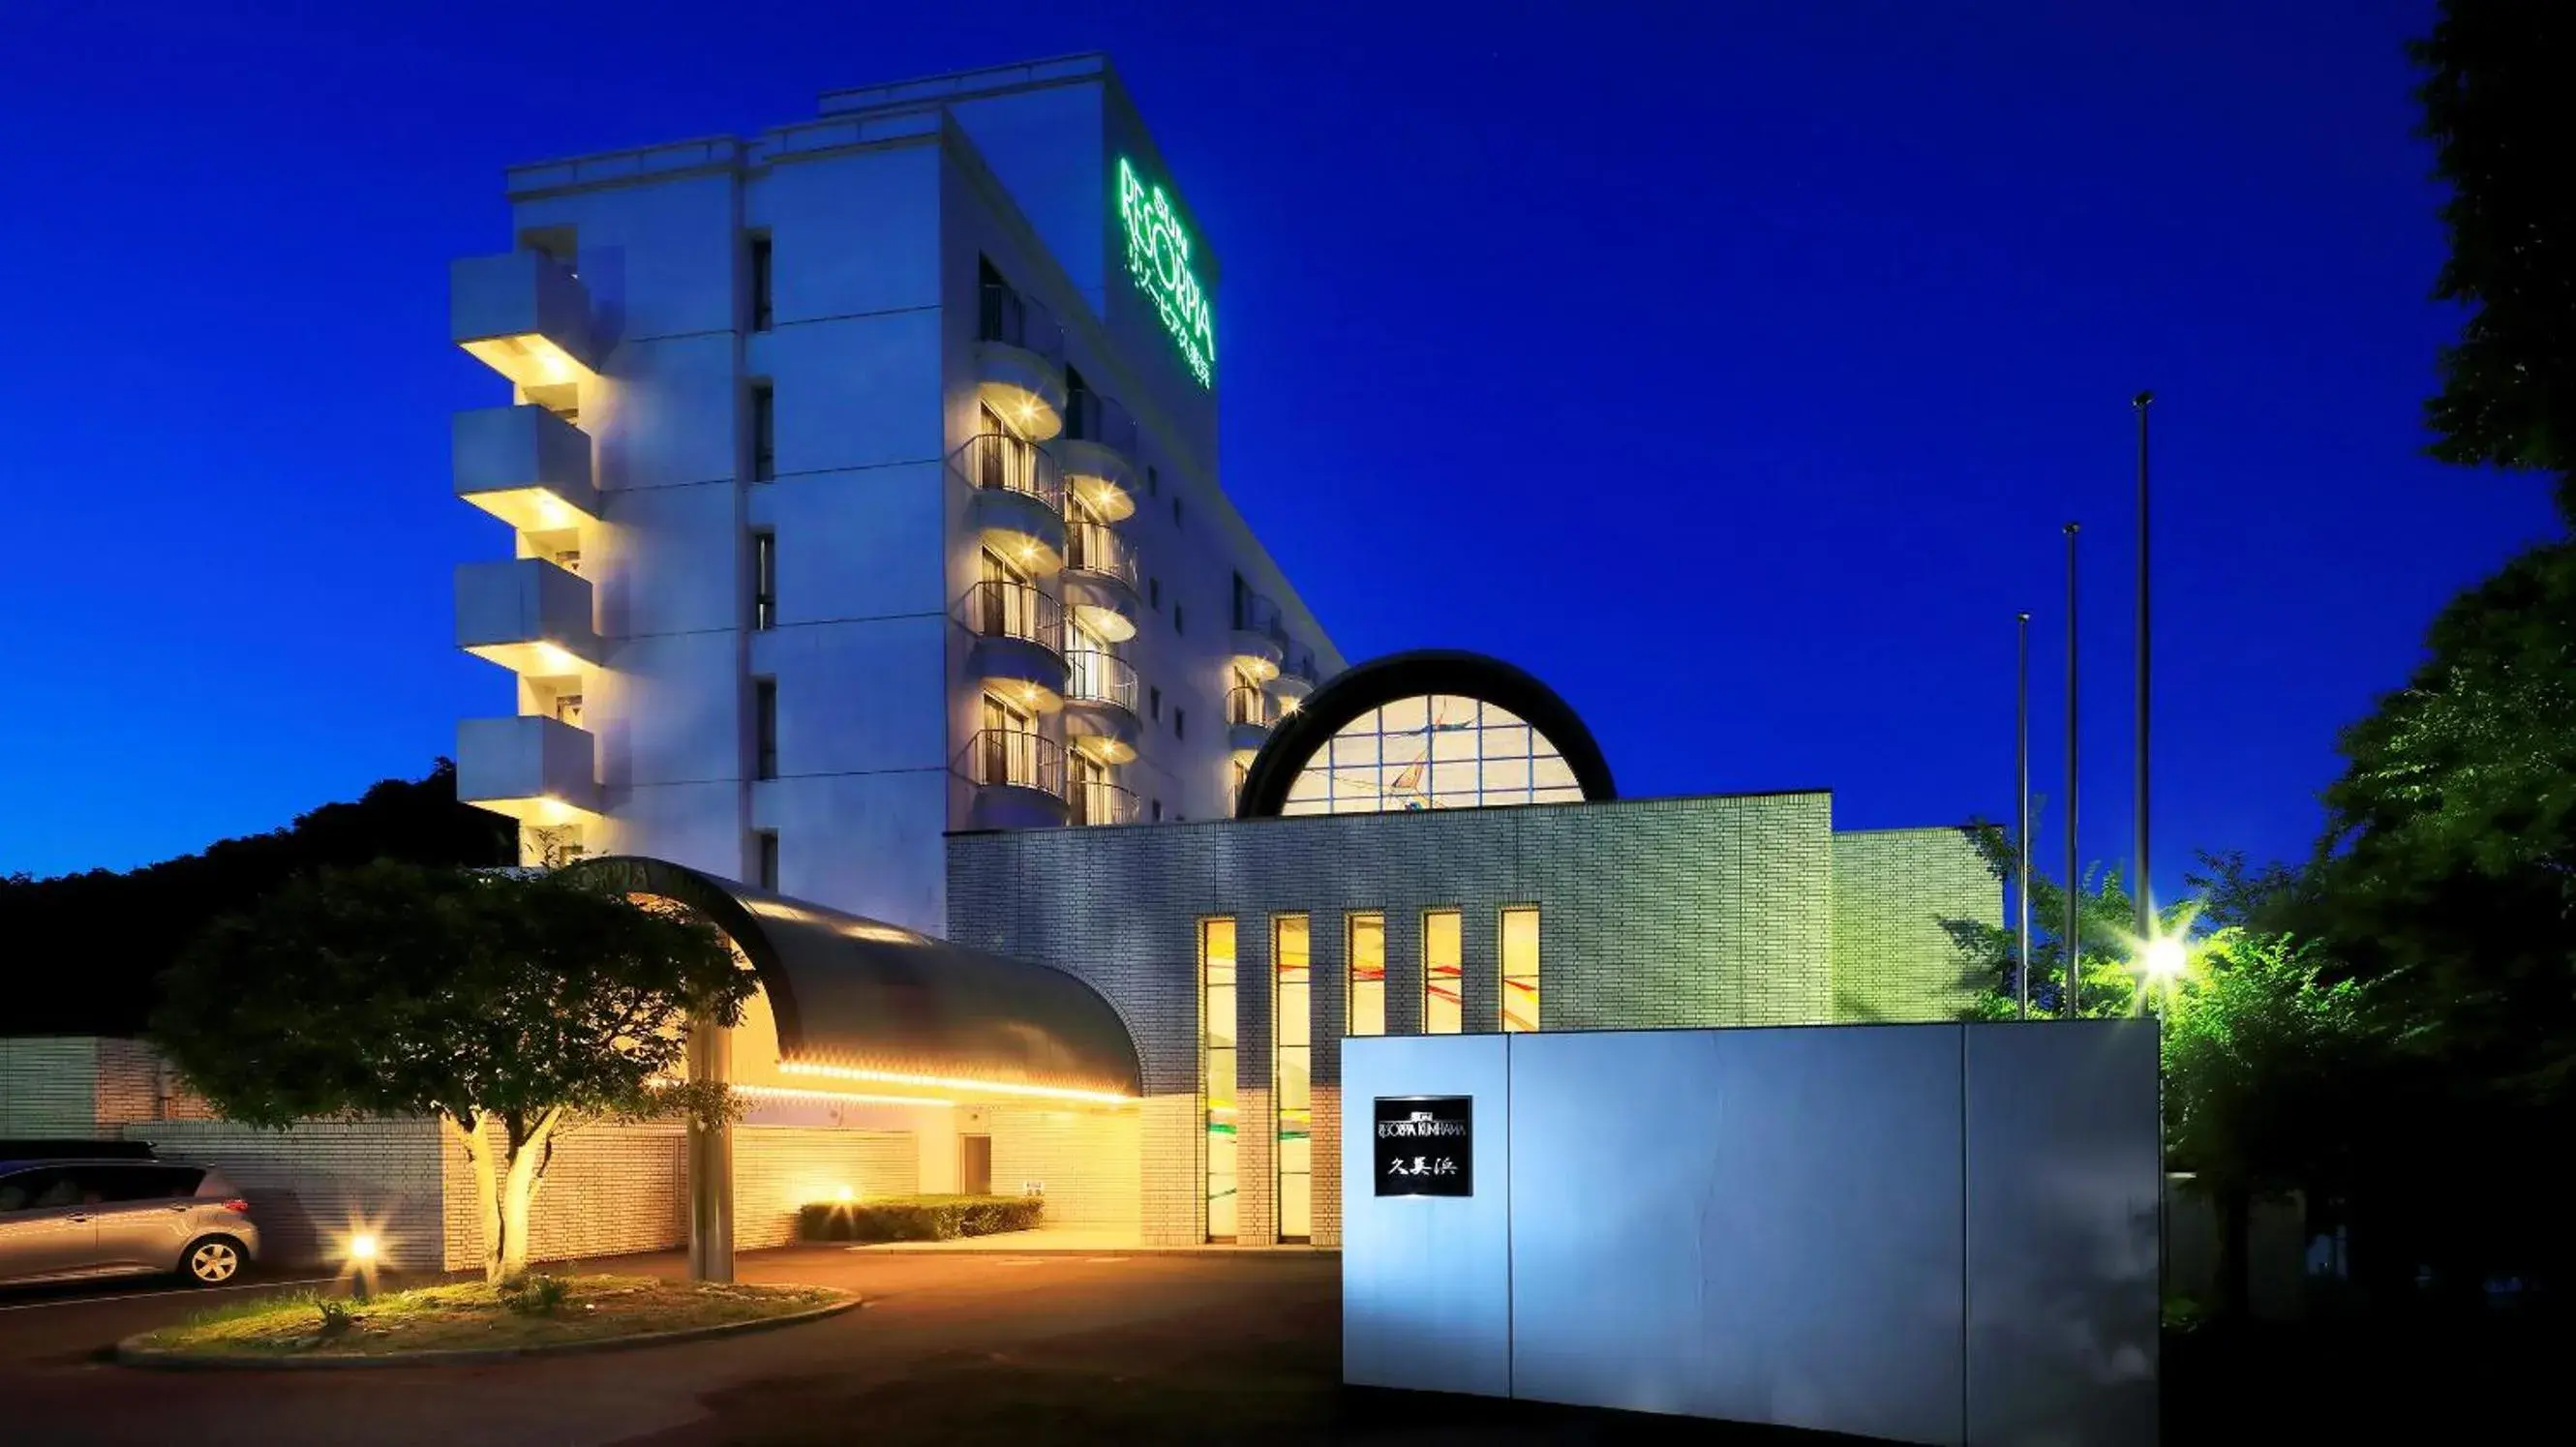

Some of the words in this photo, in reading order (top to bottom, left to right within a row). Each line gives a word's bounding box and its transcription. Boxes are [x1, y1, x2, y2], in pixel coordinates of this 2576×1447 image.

[1119, 157, 1215, 361] RESORPIA
[1387, 1157, 1458, 1175] 久美浜
